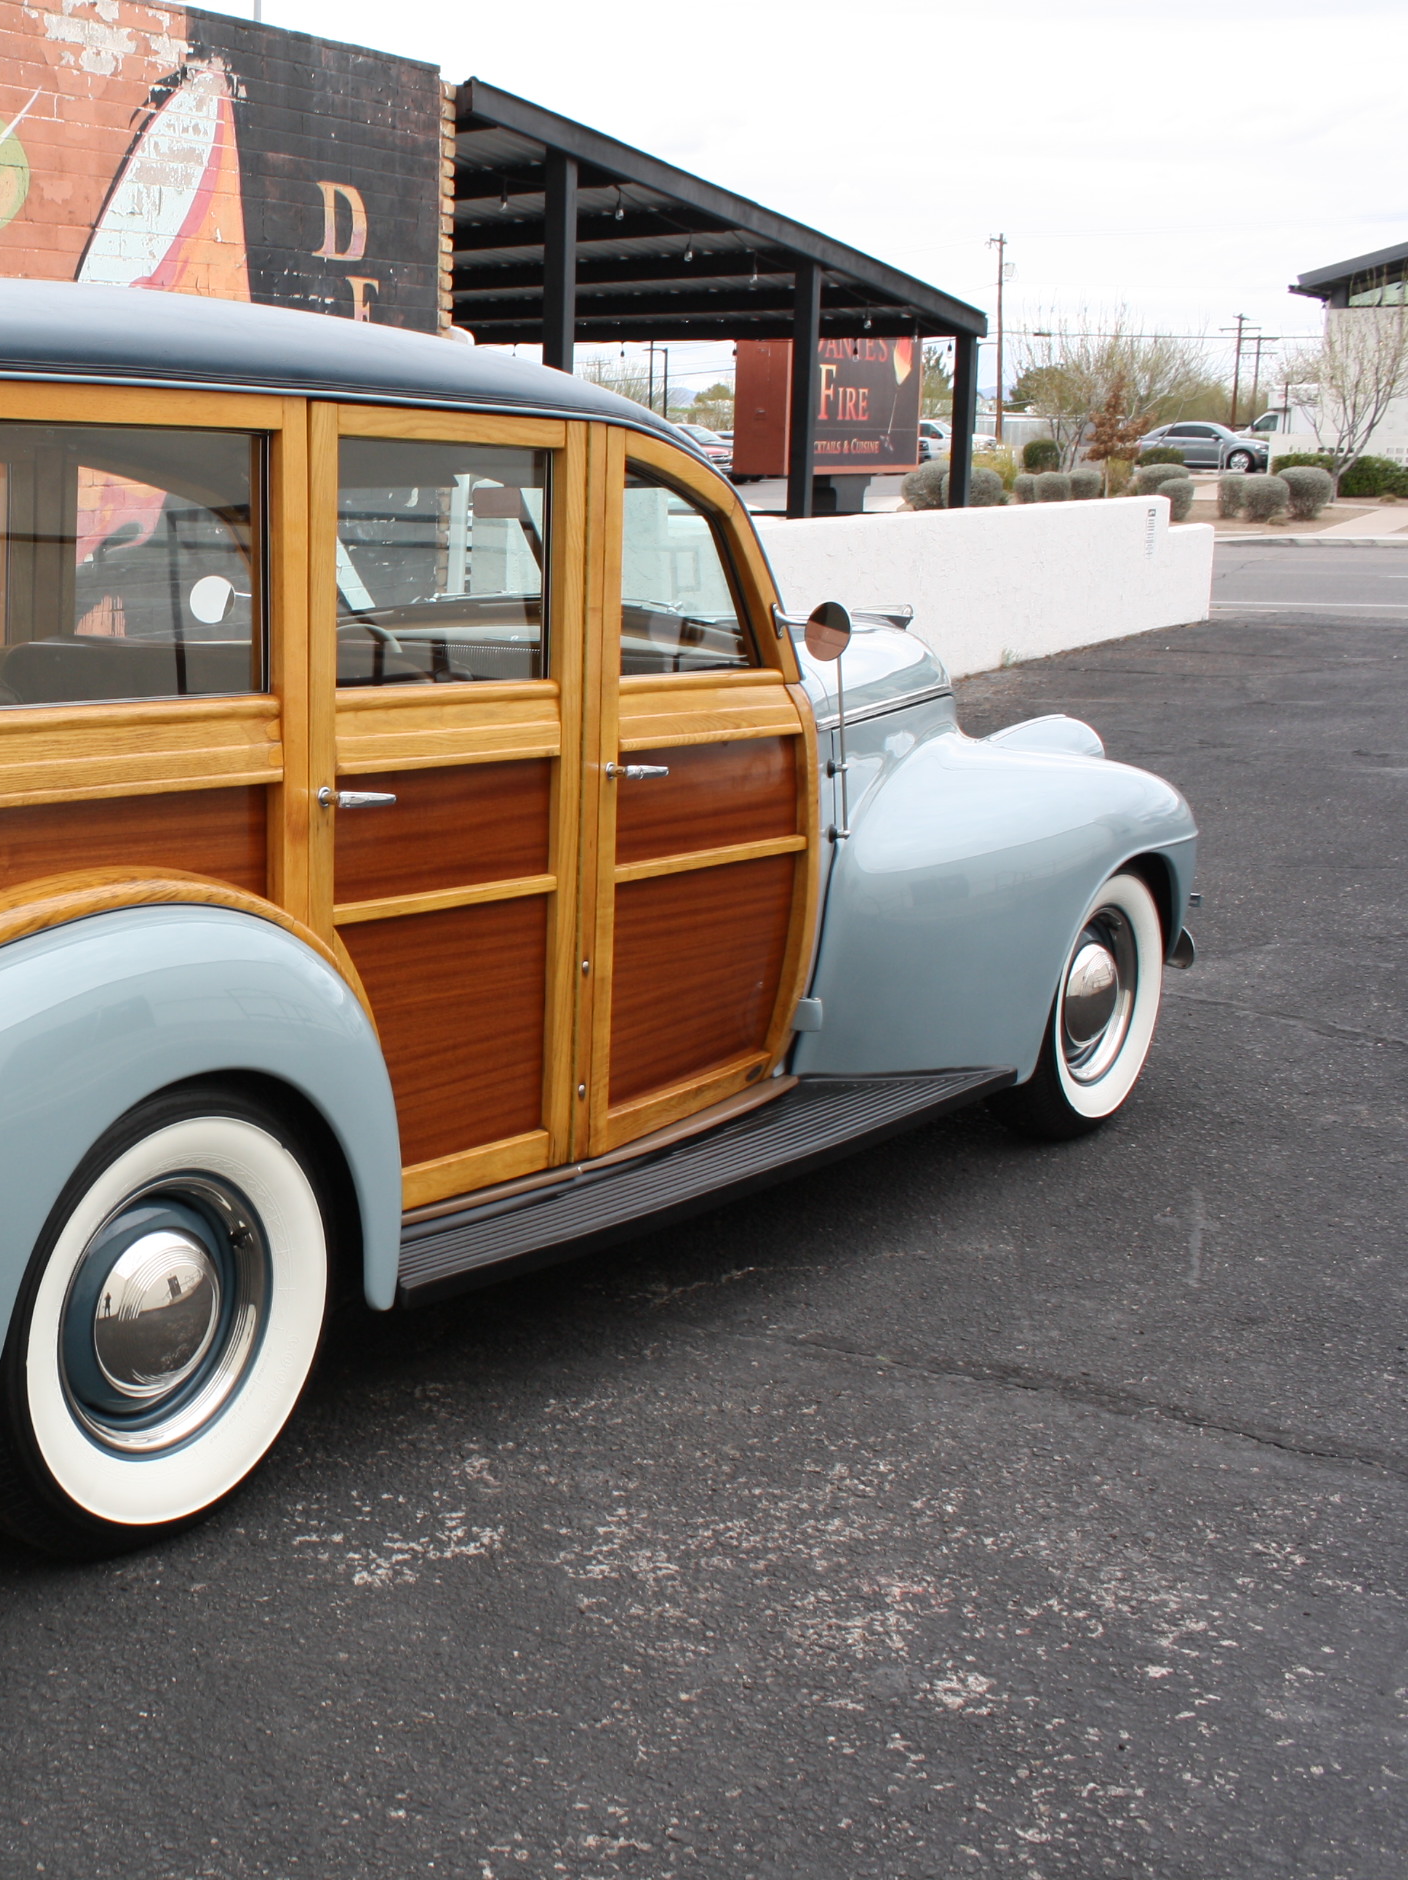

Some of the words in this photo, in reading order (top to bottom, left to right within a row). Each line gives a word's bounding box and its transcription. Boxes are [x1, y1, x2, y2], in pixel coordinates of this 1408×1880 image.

[311, 181, 367, 262] D
[817, 363, 870, 421] FIRE
[843, 440, 850, 454] &
[851, 438, 880, 454] CUISINE
